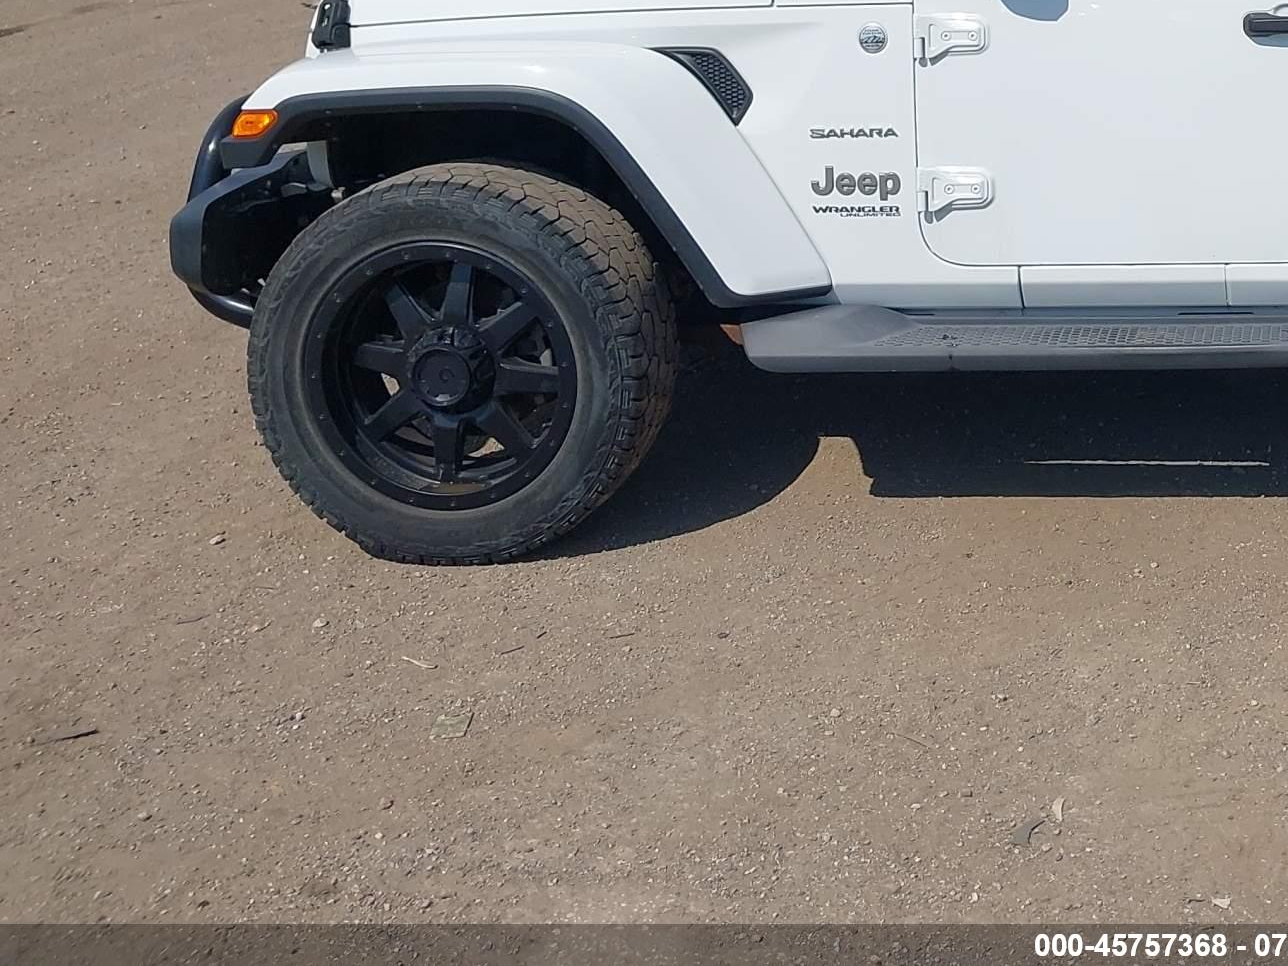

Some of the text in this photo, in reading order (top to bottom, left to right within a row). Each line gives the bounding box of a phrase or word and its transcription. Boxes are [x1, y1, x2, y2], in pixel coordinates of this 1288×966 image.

[809, 128, 899, 139] SAHARA
[810, 165, 901, 201] Jeep
[812, 205, 900, 213] WRANGLER
